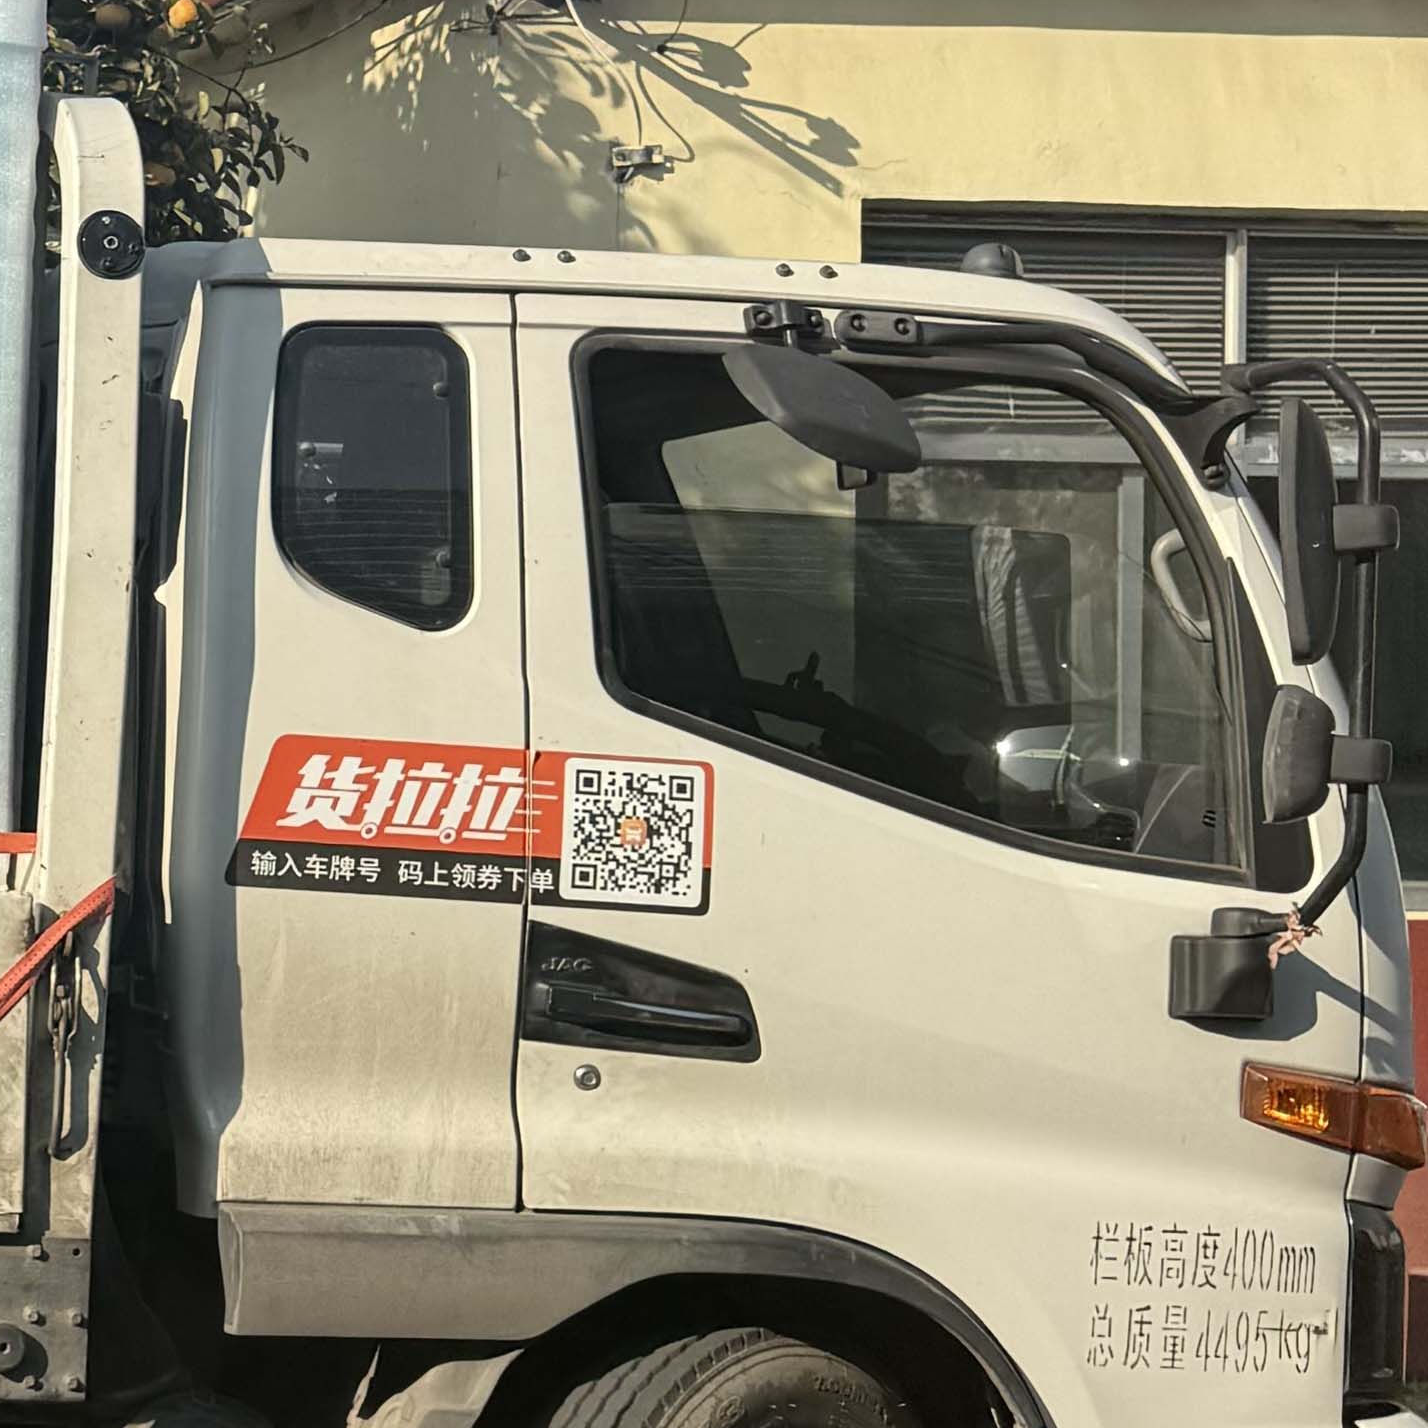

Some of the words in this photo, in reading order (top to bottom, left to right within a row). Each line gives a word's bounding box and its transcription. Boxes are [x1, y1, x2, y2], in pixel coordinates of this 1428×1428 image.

[276, 753, 528, 845] 货拉拉
[250, 849, 381, 884] 输入车牌号
[397, 859, 555, 894] 码上领券下单
[1089, 1220, 1317, 1294] 栏板高度400mm
[1086, 1302, 1313, 1374] 总质量4495kg
